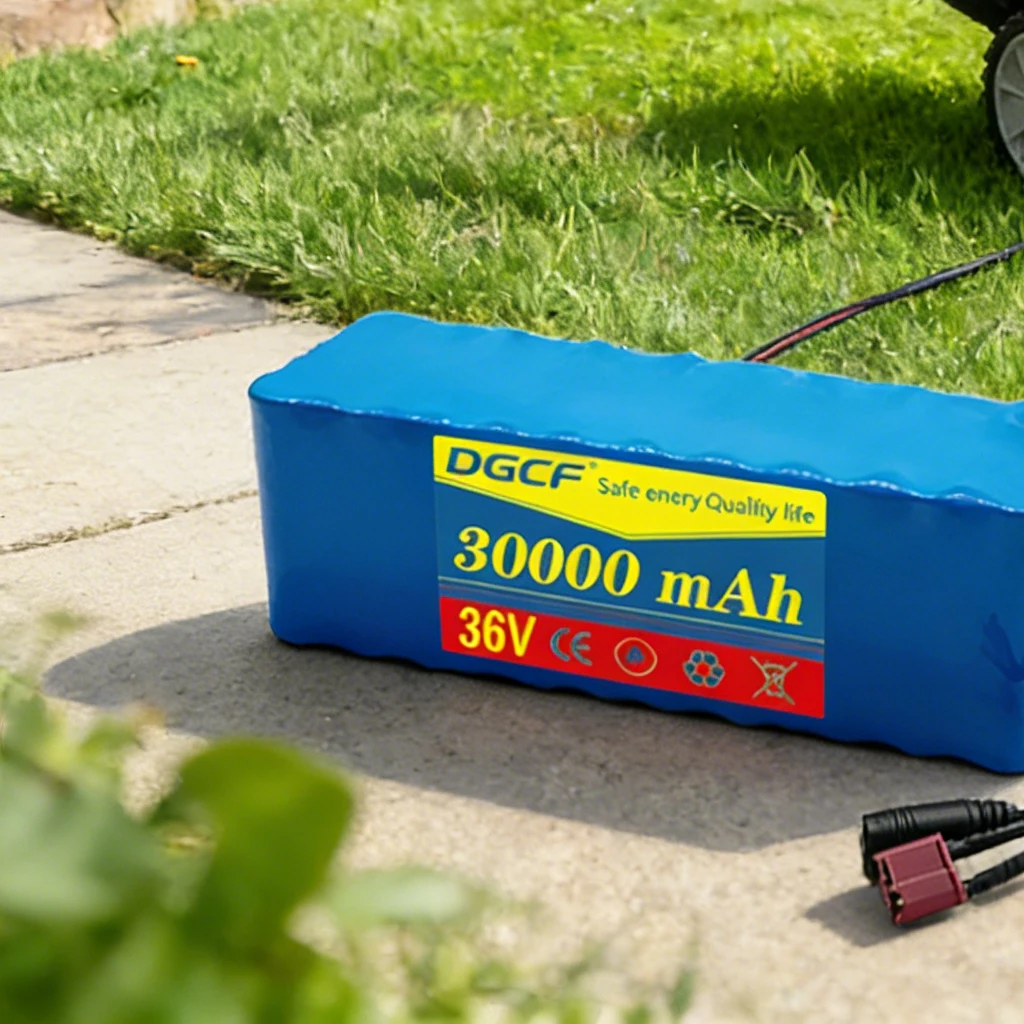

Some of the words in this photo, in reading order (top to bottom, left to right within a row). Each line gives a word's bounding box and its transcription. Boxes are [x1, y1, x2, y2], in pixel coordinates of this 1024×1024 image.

[446, 446, 586, 489] DGCF
[598, 477, 640, 499] Safe
[453, 526, 640, 597] 30000
[655, 568, 803, 625] mAh
[458, 606, 537, 657] 36V
[550, 628, 593, 666] CE
